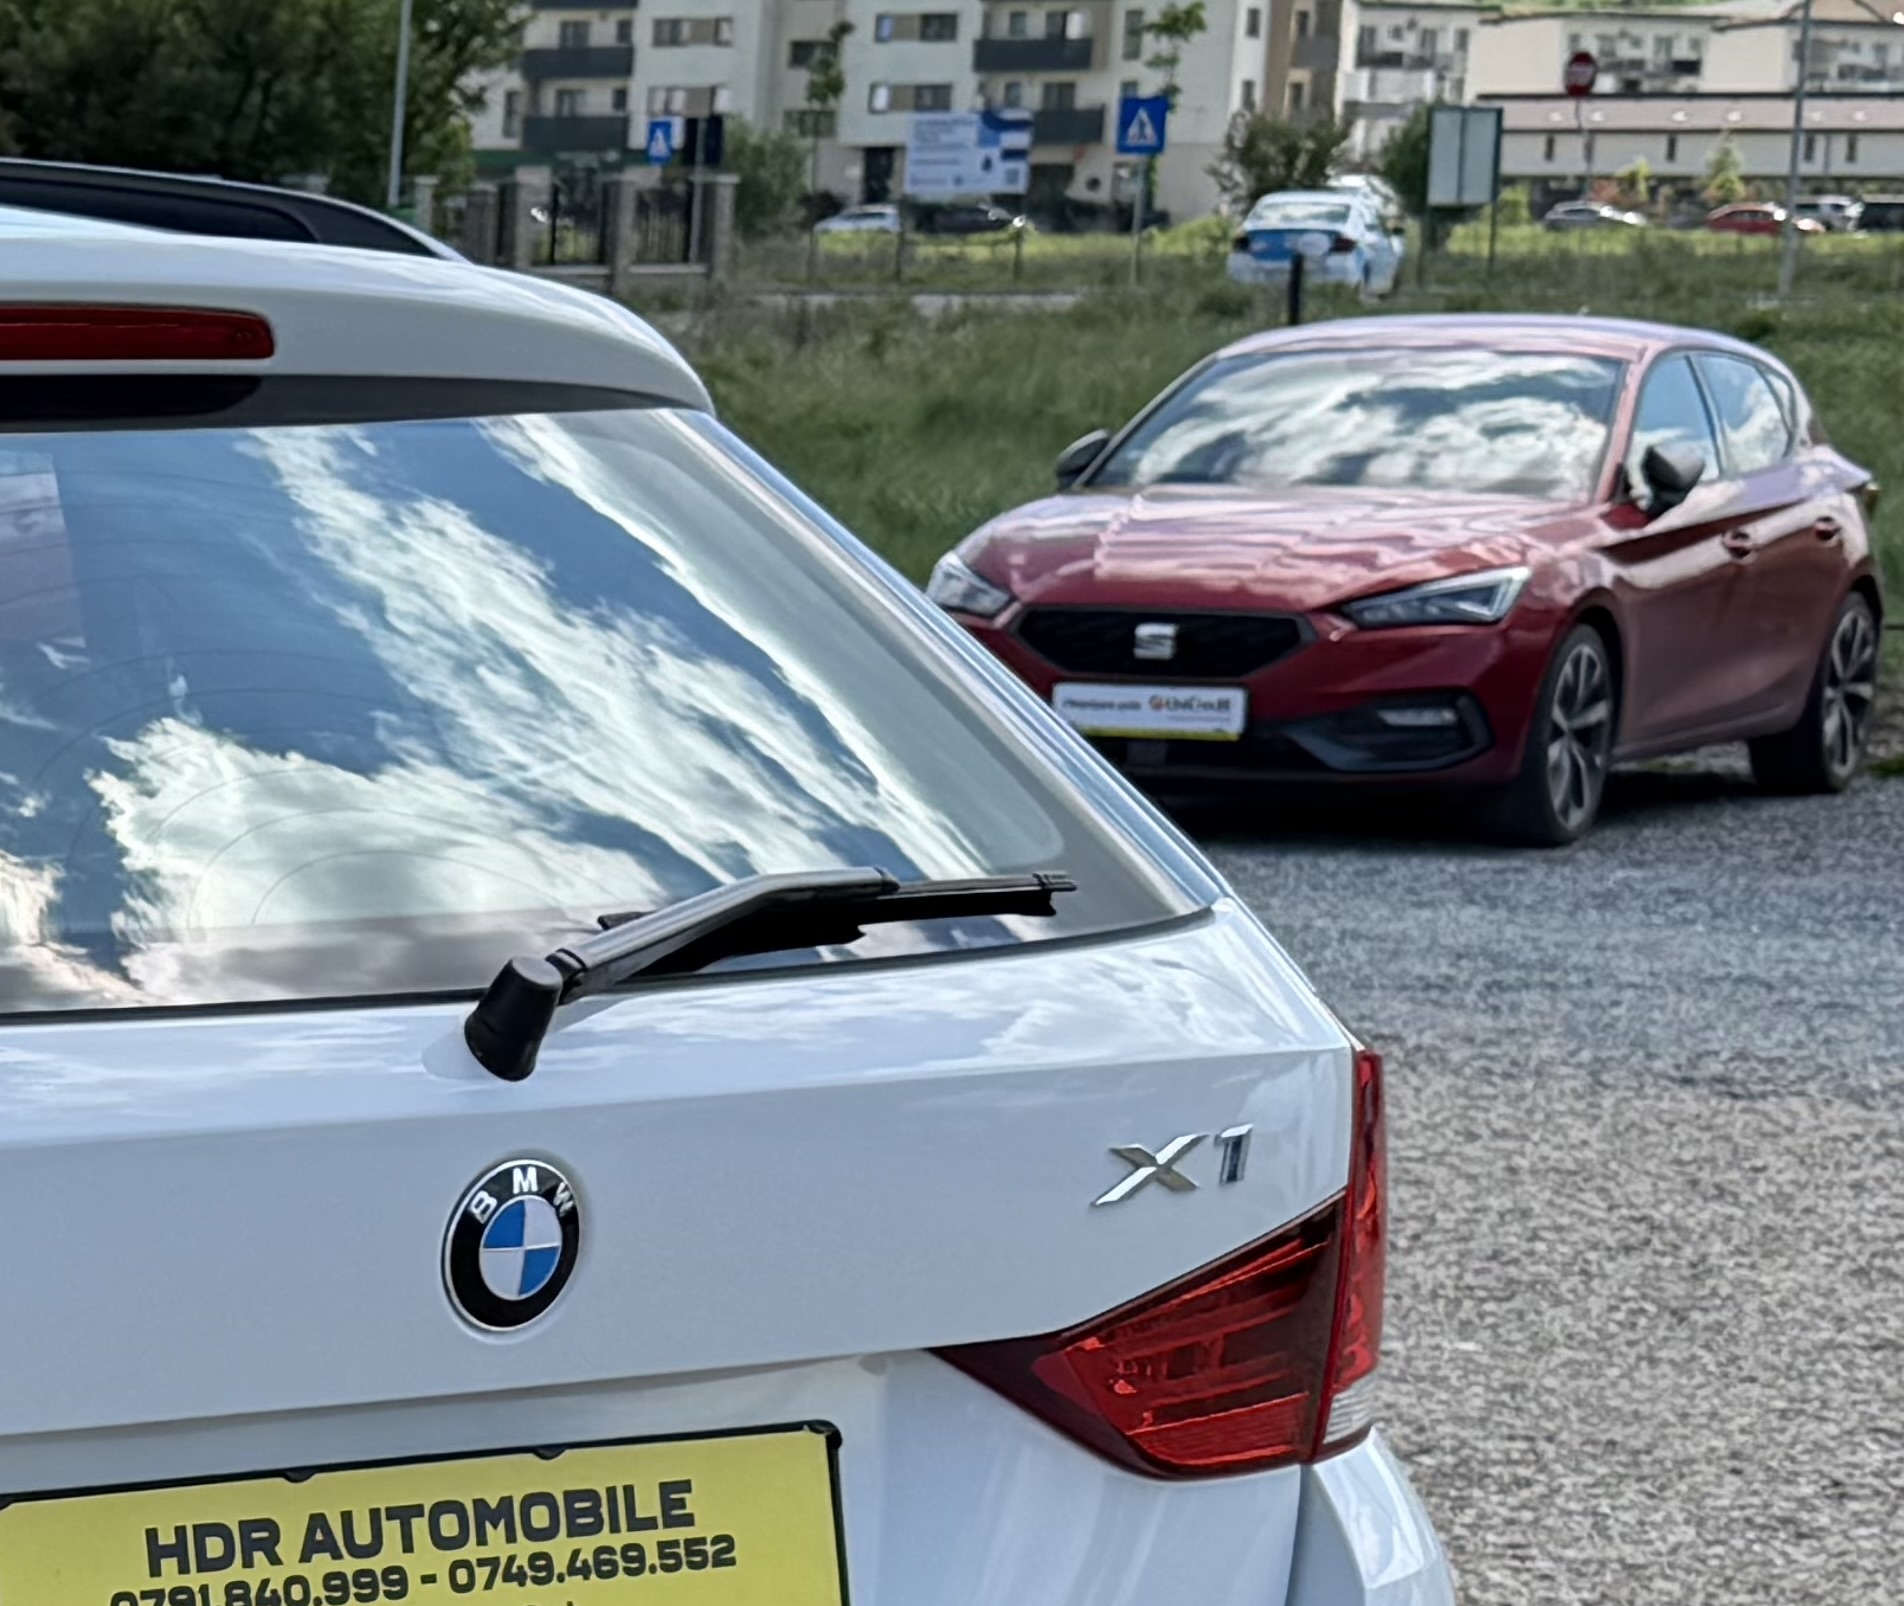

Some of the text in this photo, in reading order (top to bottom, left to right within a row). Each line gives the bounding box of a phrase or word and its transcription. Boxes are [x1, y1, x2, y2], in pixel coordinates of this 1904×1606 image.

[469, 1166, 577, 1223] BMW
[1089, 1123, 1254, 1208] X1
[145, 1479, 695, 1578] HDR AUTOMOBILE
[448, 1534, 737, 1593] 0749.469.552
